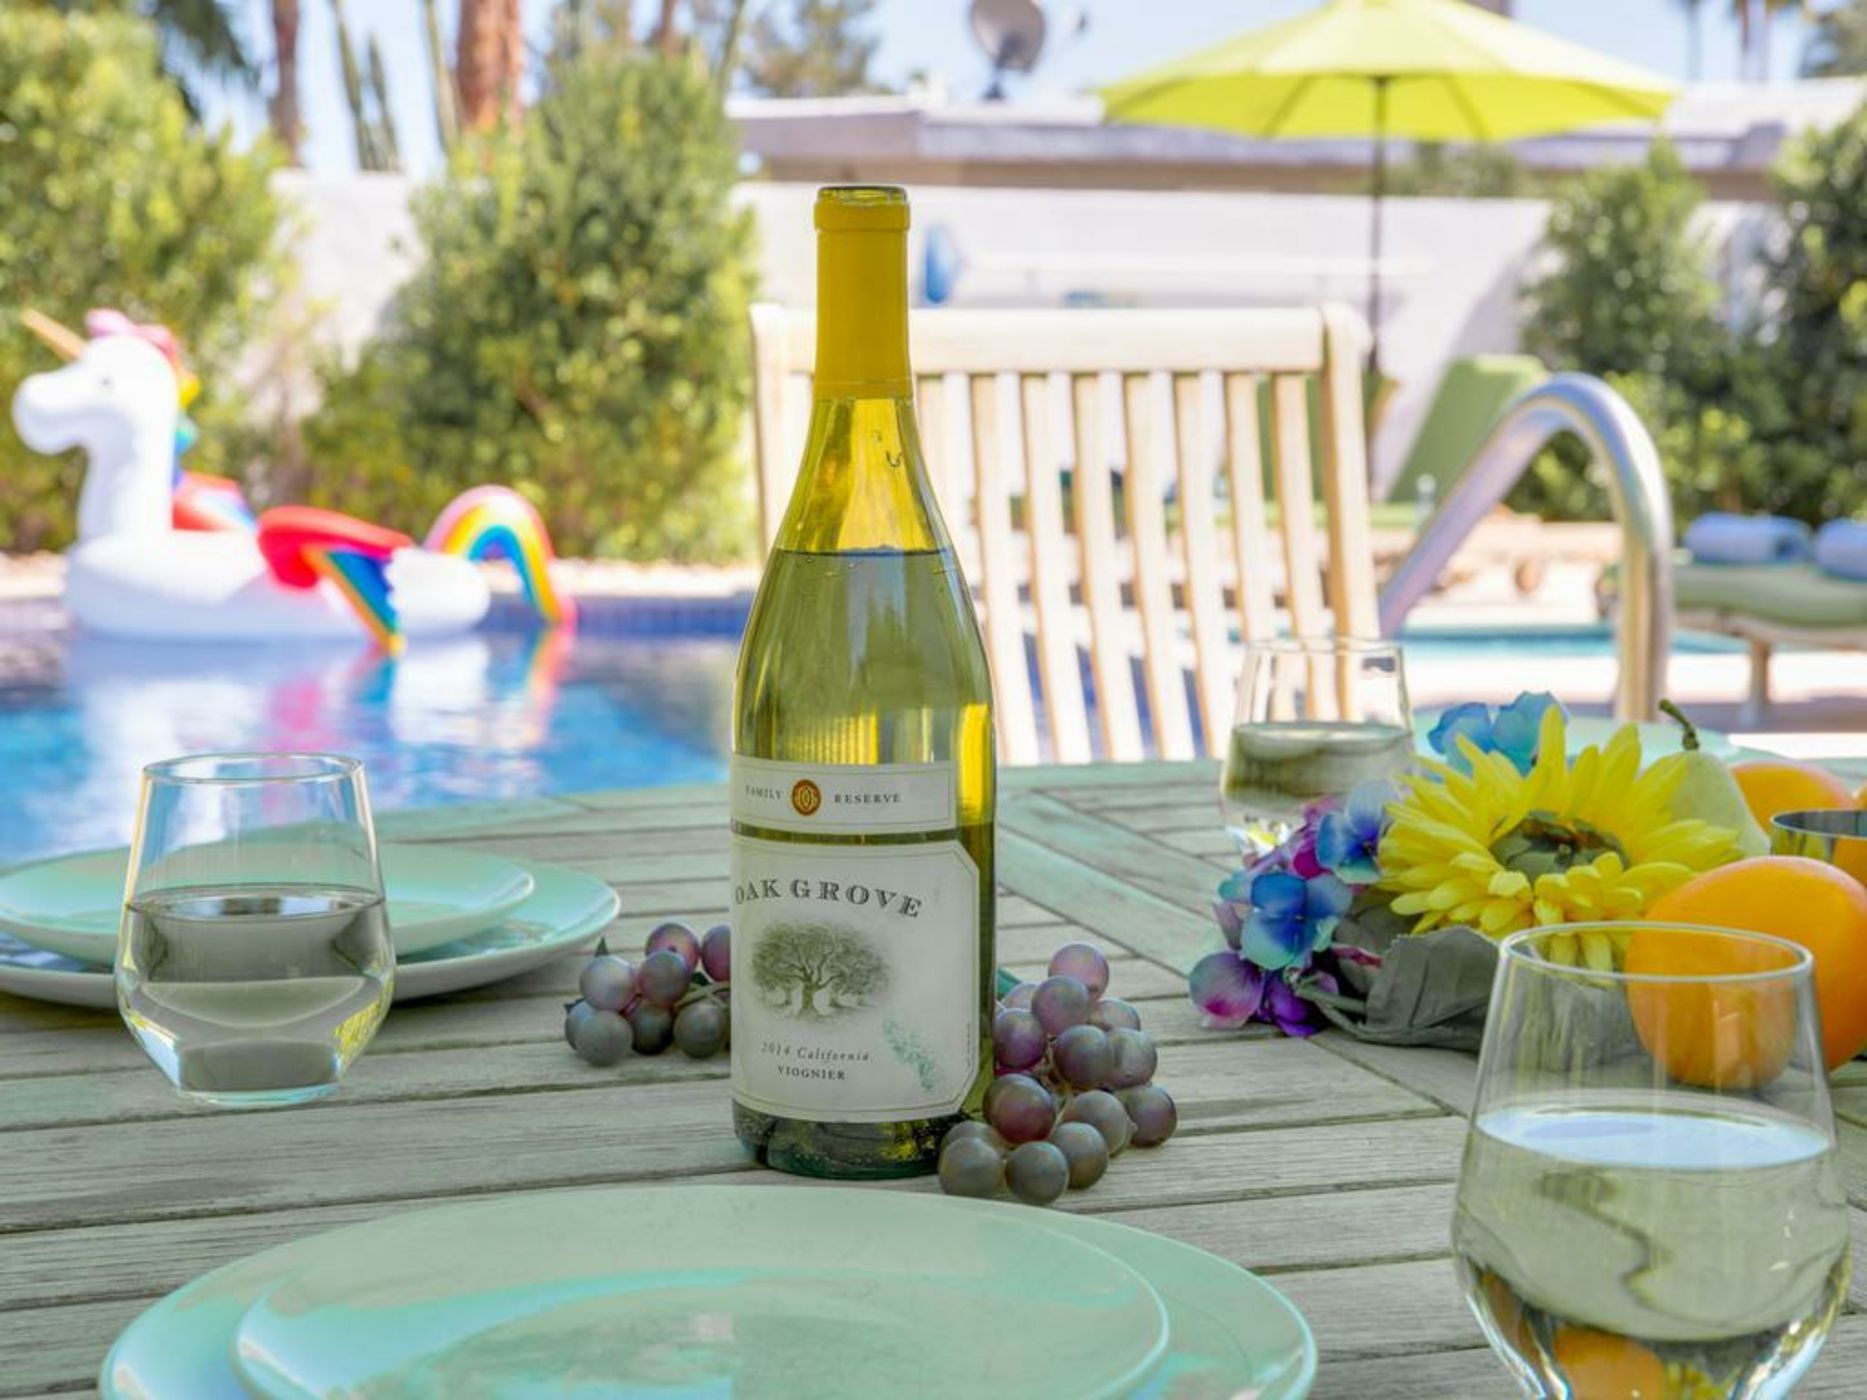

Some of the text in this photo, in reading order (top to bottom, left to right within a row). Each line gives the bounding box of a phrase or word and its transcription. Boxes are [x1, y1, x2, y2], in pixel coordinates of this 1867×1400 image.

[745, 785, 902, 804] FAMILY RESERVE
[735, 878, 923, 918] OAK GROVE
[760, 1041, 869, 1063] 2014 California
[778, 1065, 846, 1081] VIOGNIER
